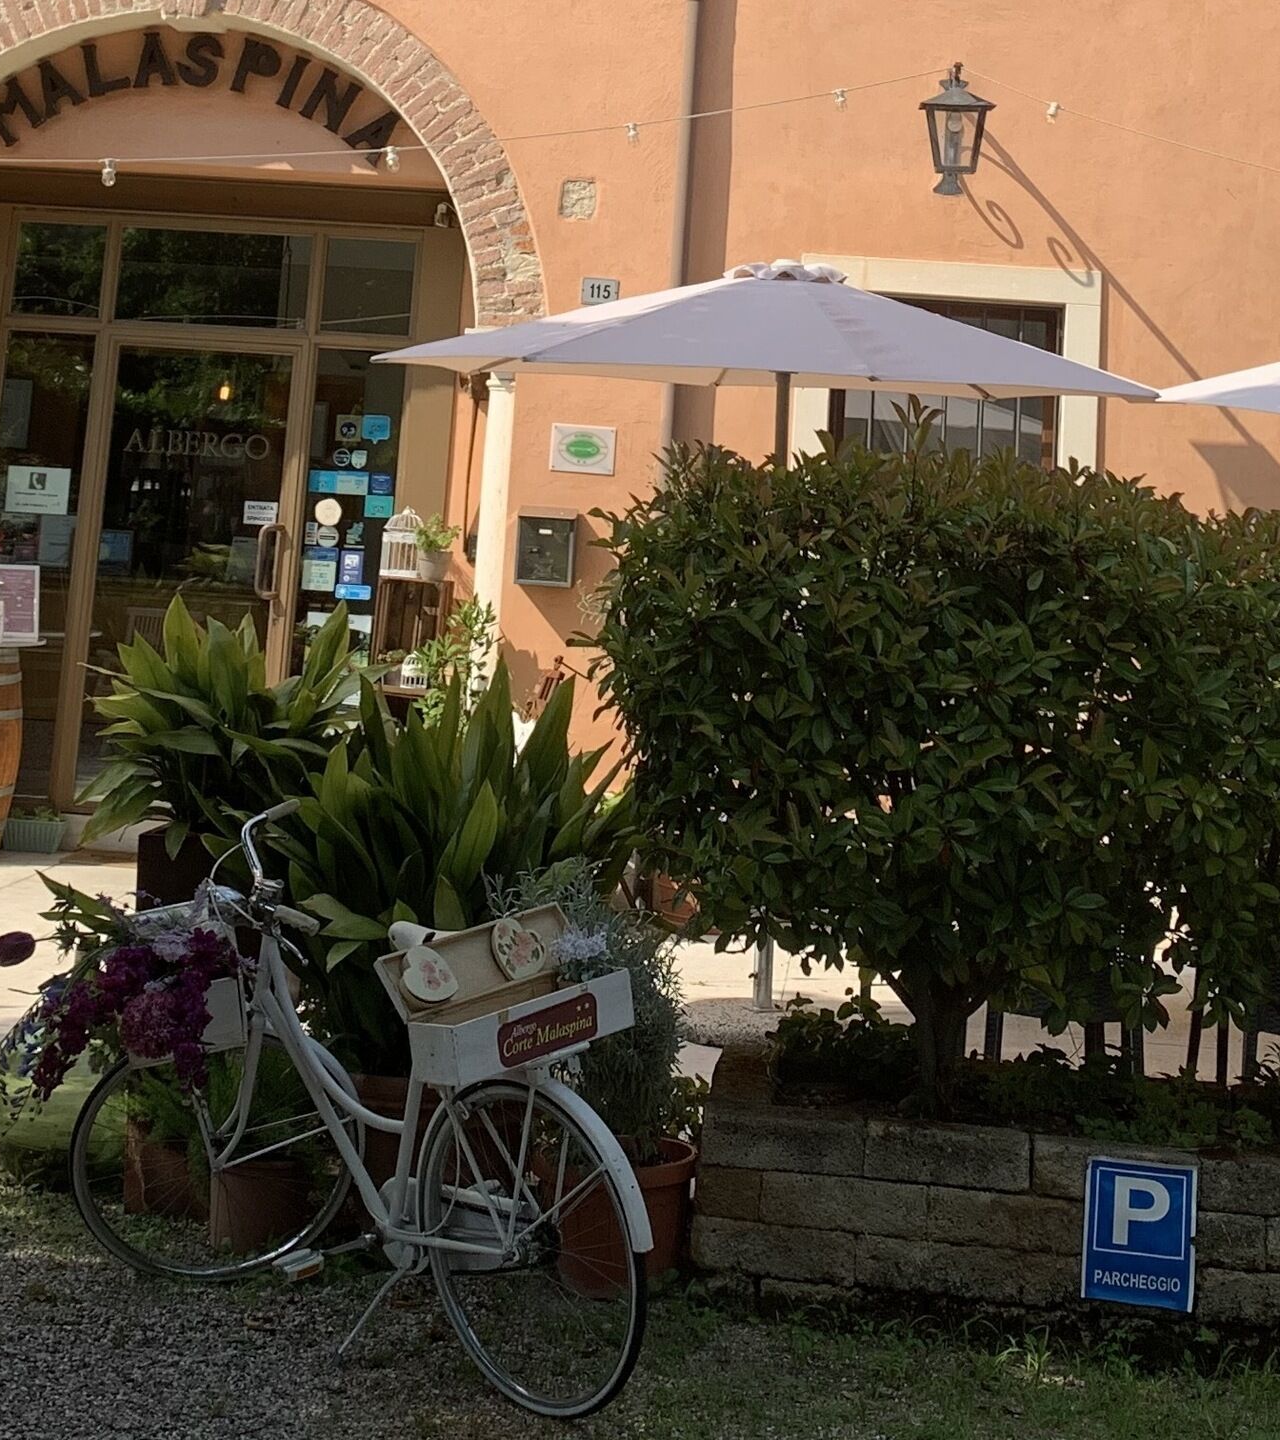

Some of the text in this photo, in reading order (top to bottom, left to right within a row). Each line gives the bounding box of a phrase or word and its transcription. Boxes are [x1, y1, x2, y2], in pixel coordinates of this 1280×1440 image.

[590, 283, 611, 299] 115
[122, 428, 270, 460] ALBERGO
[503, 1016, 593, 1057] Corte Malaspina
[511, 1022, 538, 1038] Albergo
[1112, 1175, 1170, 1246] P
[1093, 1269, 1181, 1293] PARCHEGGIO
